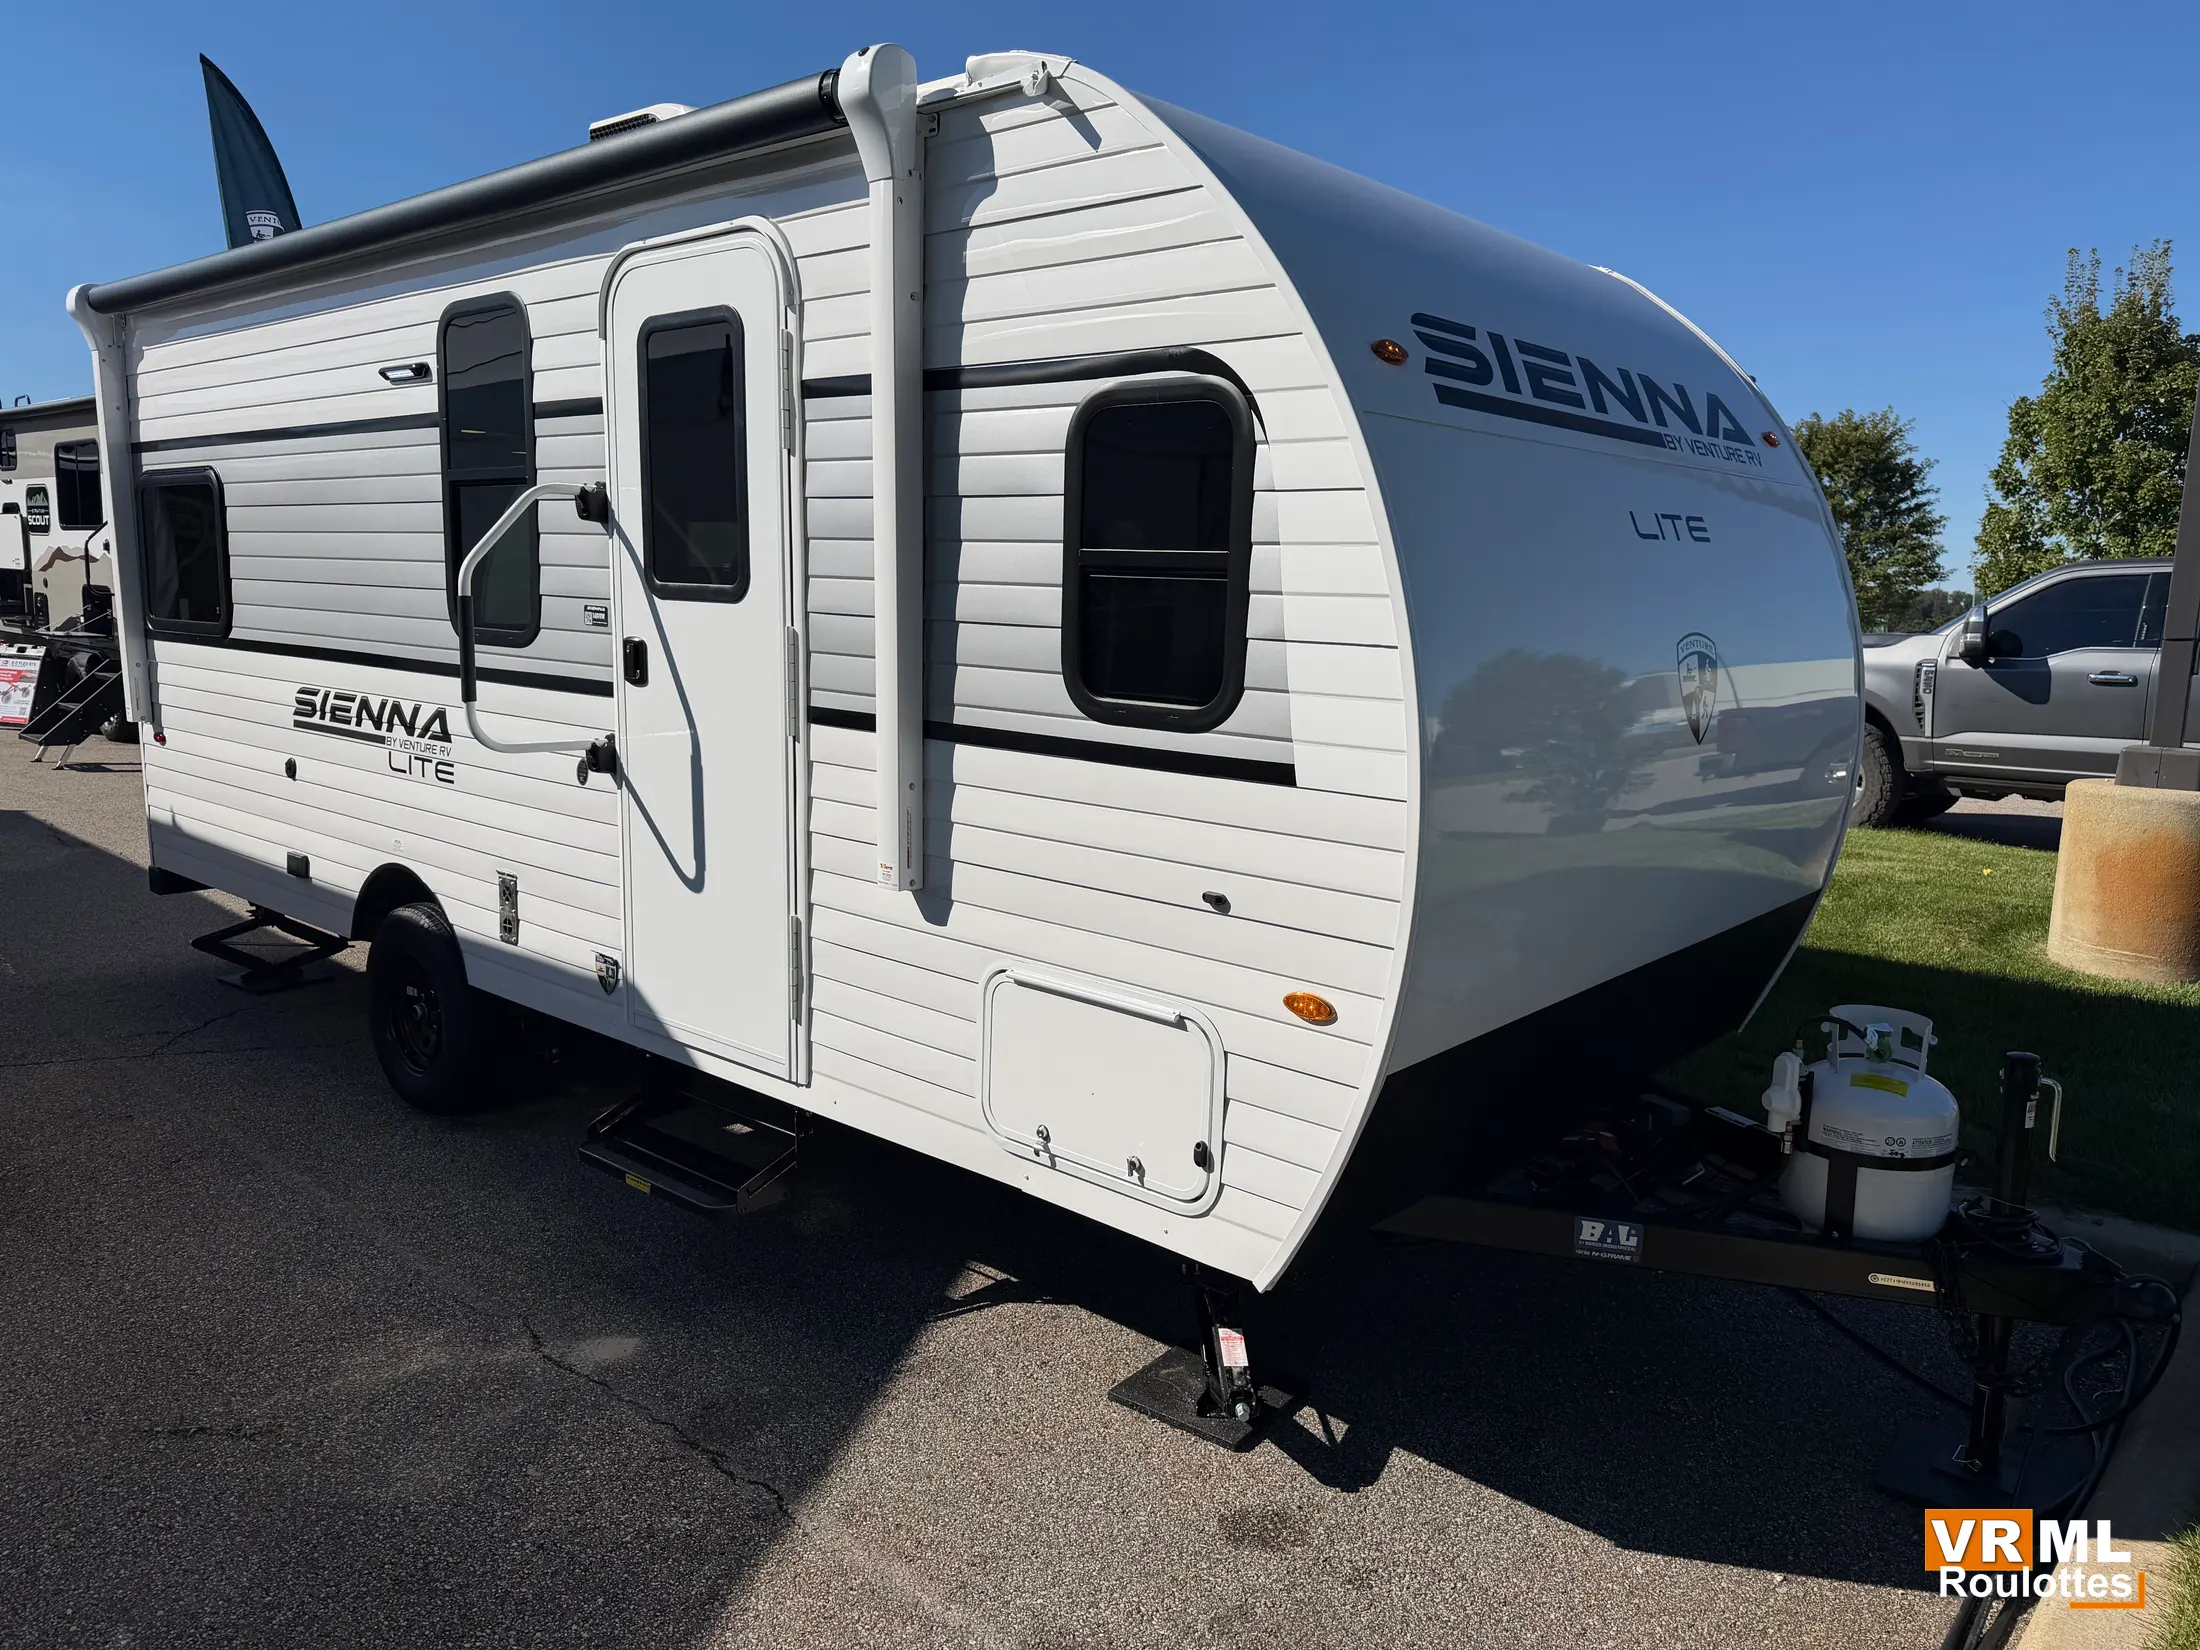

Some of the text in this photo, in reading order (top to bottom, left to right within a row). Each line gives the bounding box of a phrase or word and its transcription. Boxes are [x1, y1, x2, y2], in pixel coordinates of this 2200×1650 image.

[1410, 312, 1756, 447] SIENNA
[1663, 433, 1763, 468] BY VENTURE RV
[28, 514, 50, 526] SCOUT
[1629, 510, 1712, 543] LITE
[1680, 639, 1715, 655] VENTURE
[293, 686, 452, 744] SIENNA
[386, 736, 452, 757] BY VENTURE RV
[388, 750, 455, 785] LITE
[1579, 1220, 1638, 1247] BAL
